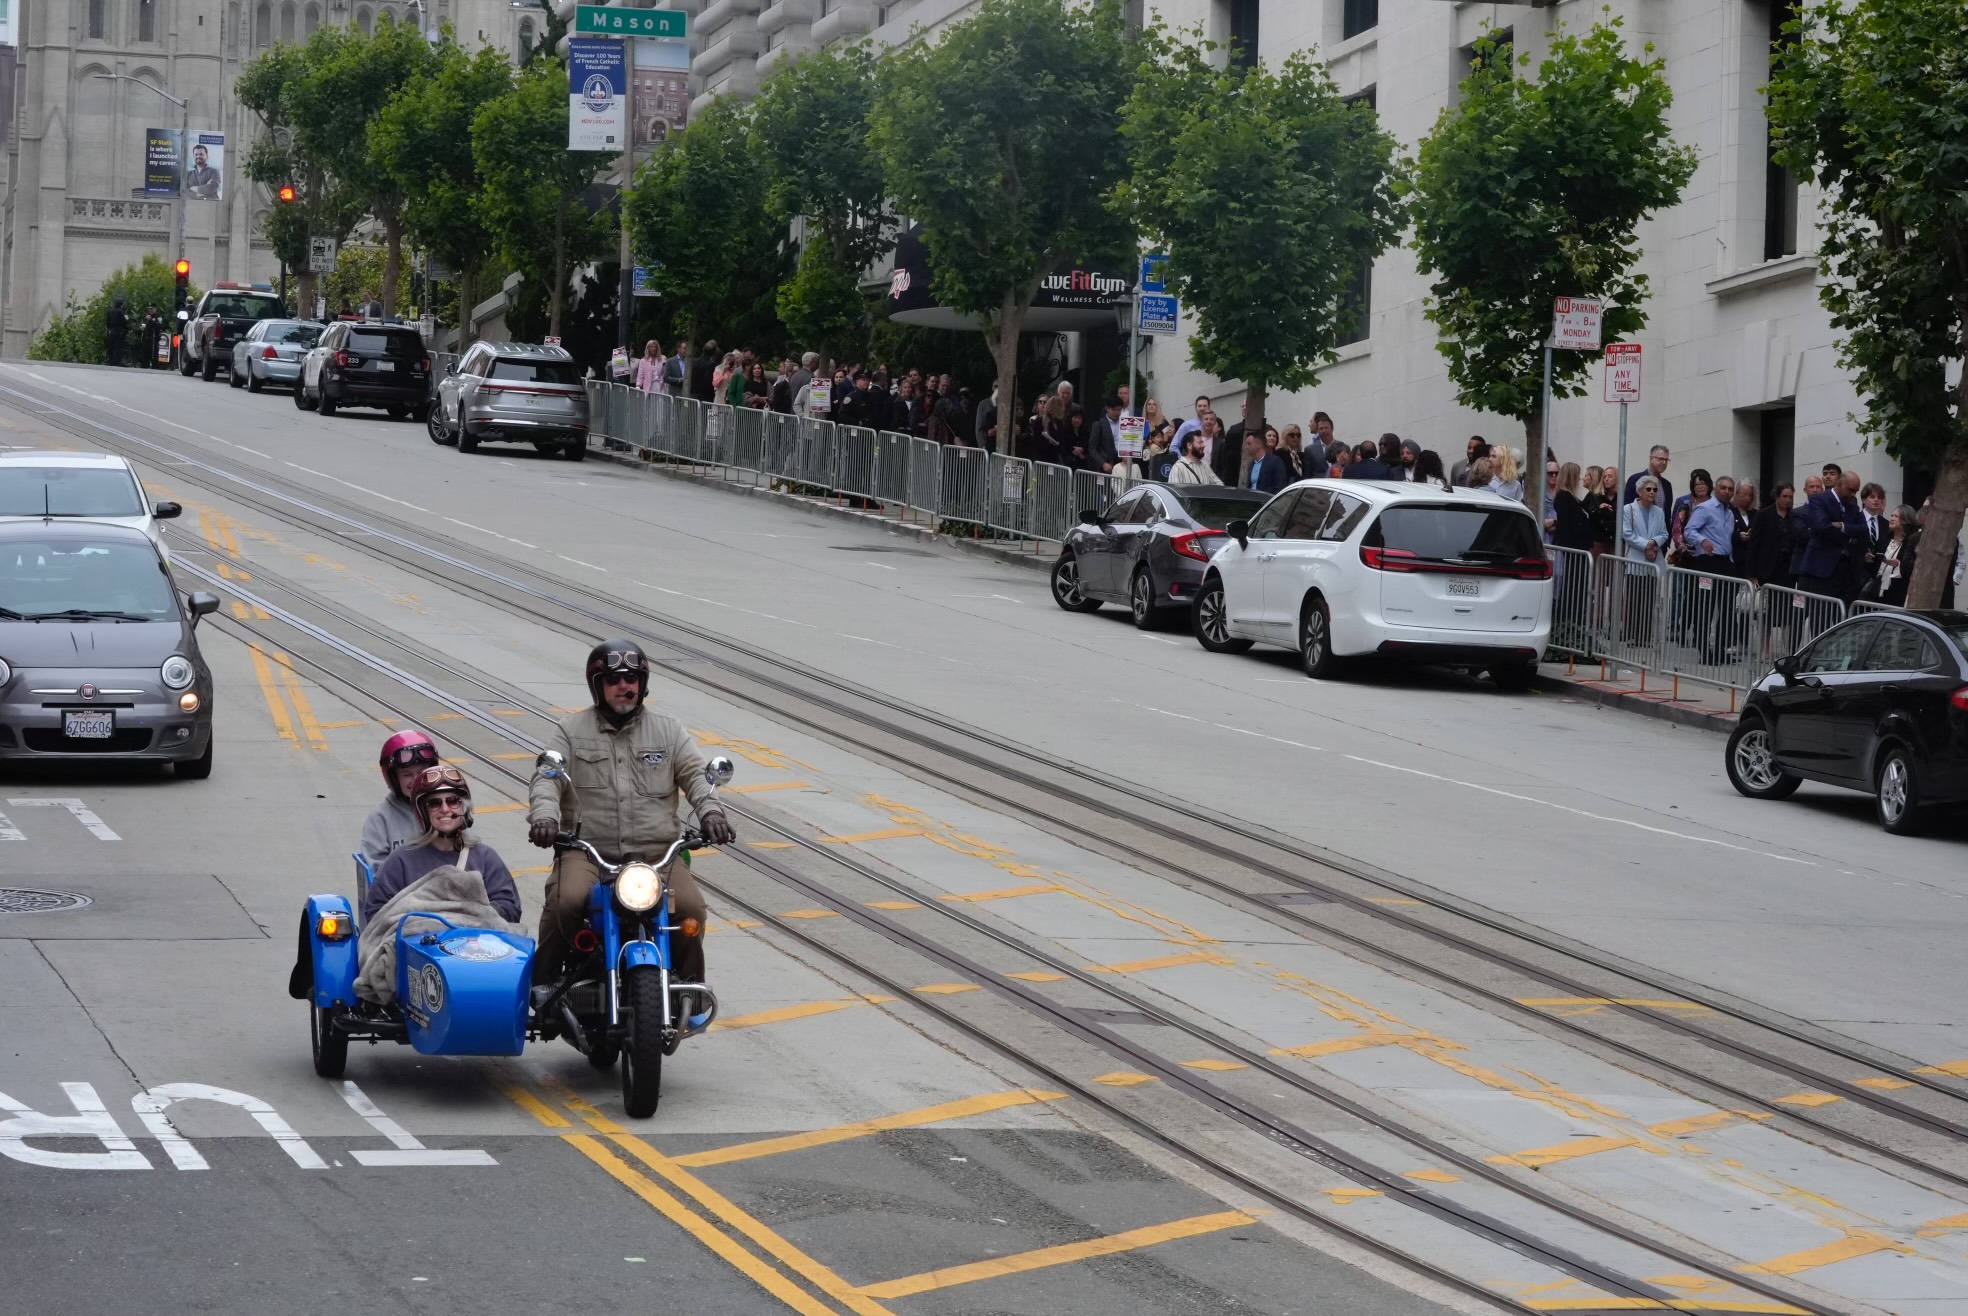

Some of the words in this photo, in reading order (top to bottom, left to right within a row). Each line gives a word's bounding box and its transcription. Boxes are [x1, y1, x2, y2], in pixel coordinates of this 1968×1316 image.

[593, 12, 670, 31] Mason
[1143, 297, 1156, 306] Pay
[1157, 298, 1167, 307] by
[1556, 298, 1569, 312] NO
[1571, 303, 1599, 314] PARKING
[1143, 305, 1169, 313] License
[1143, 312, 1160, 320] Plate
[1143, 321, 1173, 329] 35009004
[1563, 328, 1592, 338] MONDAY
[1606, 353, 1616, 365] NO
[1616, 355, 1640, 365] STOPPING
[1614, 370, 1631, 379] ANY
[1613, 381, 1632, 390] TIME
[66, 720, 111, 733] 6ZGG606
